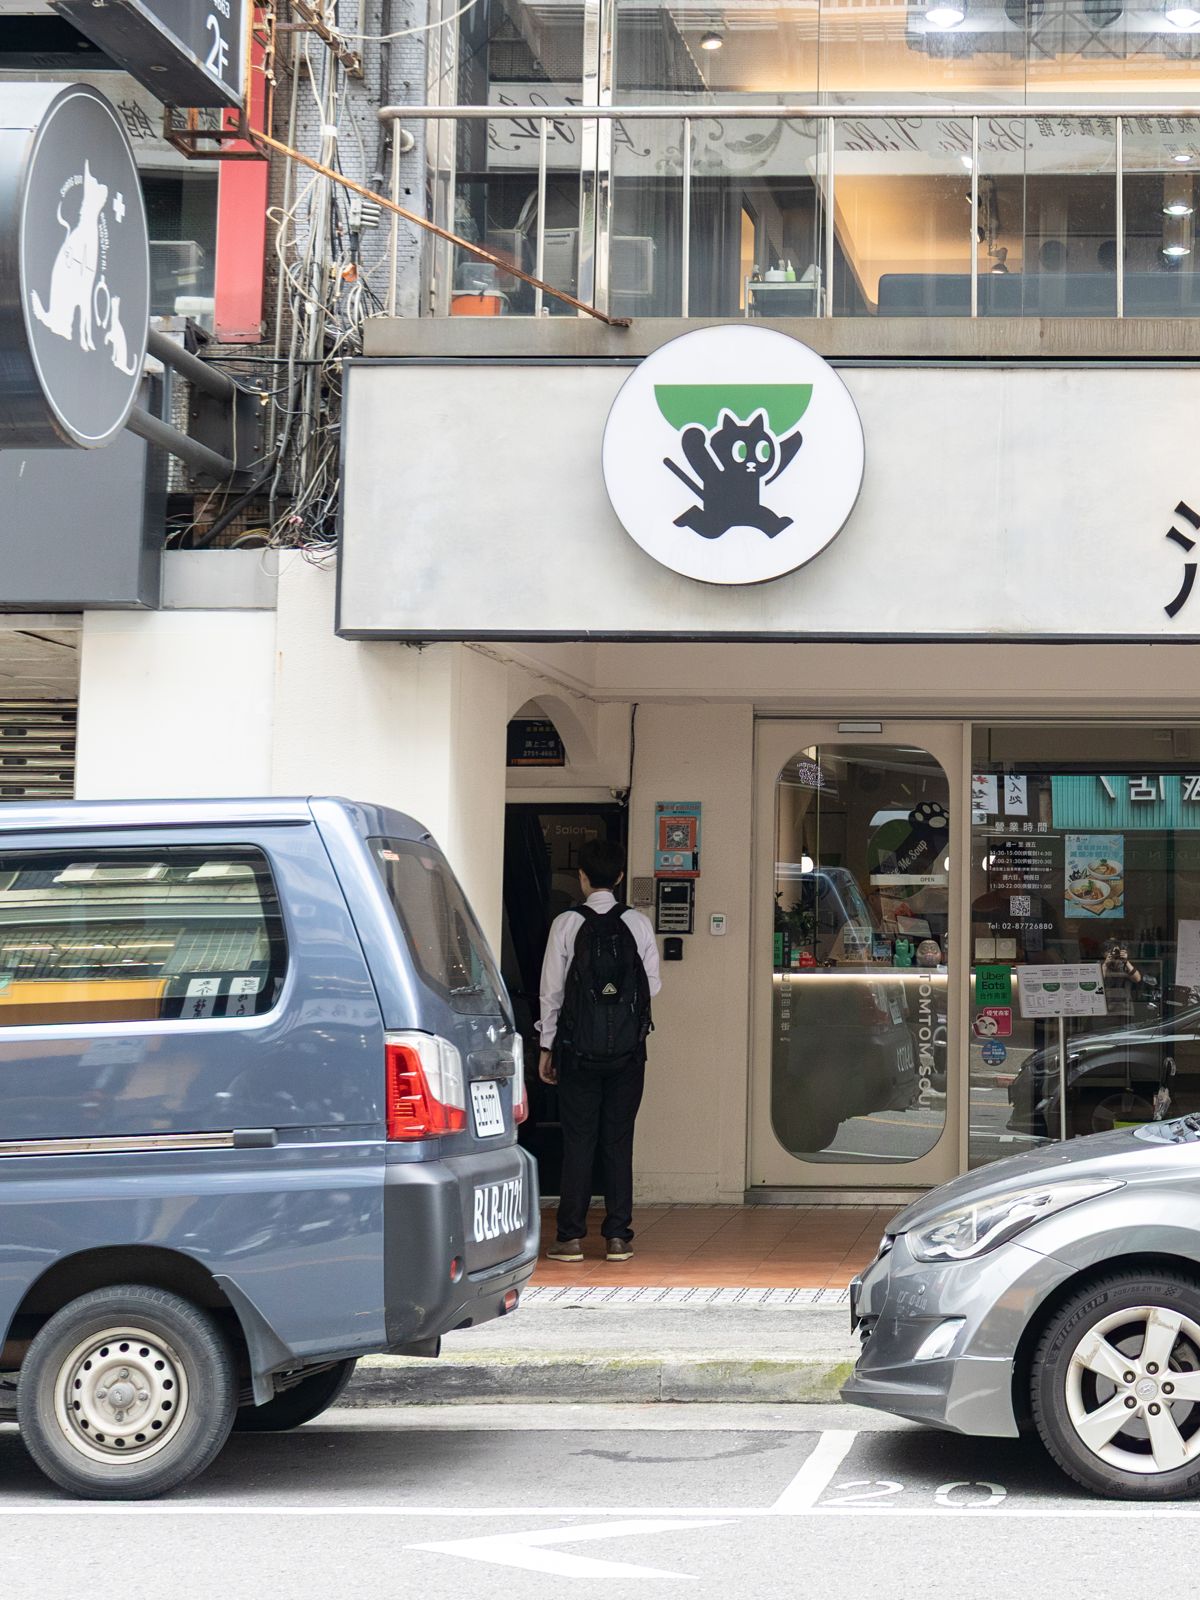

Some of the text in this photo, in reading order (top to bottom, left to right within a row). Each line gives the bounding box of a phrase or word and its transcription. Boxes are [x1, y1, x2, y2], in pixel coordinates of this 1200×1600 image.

[206, 14, 229, 79] 2F
[995, 822, 1048, 832] 營業時間
[908, 839, 928, 860] Soup
[987, 922, 1053, 930] Tel: 02-87726880
[982, 971, 1004, 980] Uber
[982, 982, 1005, 990] Eats
[918, 974, 932, 1062] TOMTOM
[473, 1178, 524, 1243] BLB-0721
[1055, 1295, 1108, 1347] MICHELIN
